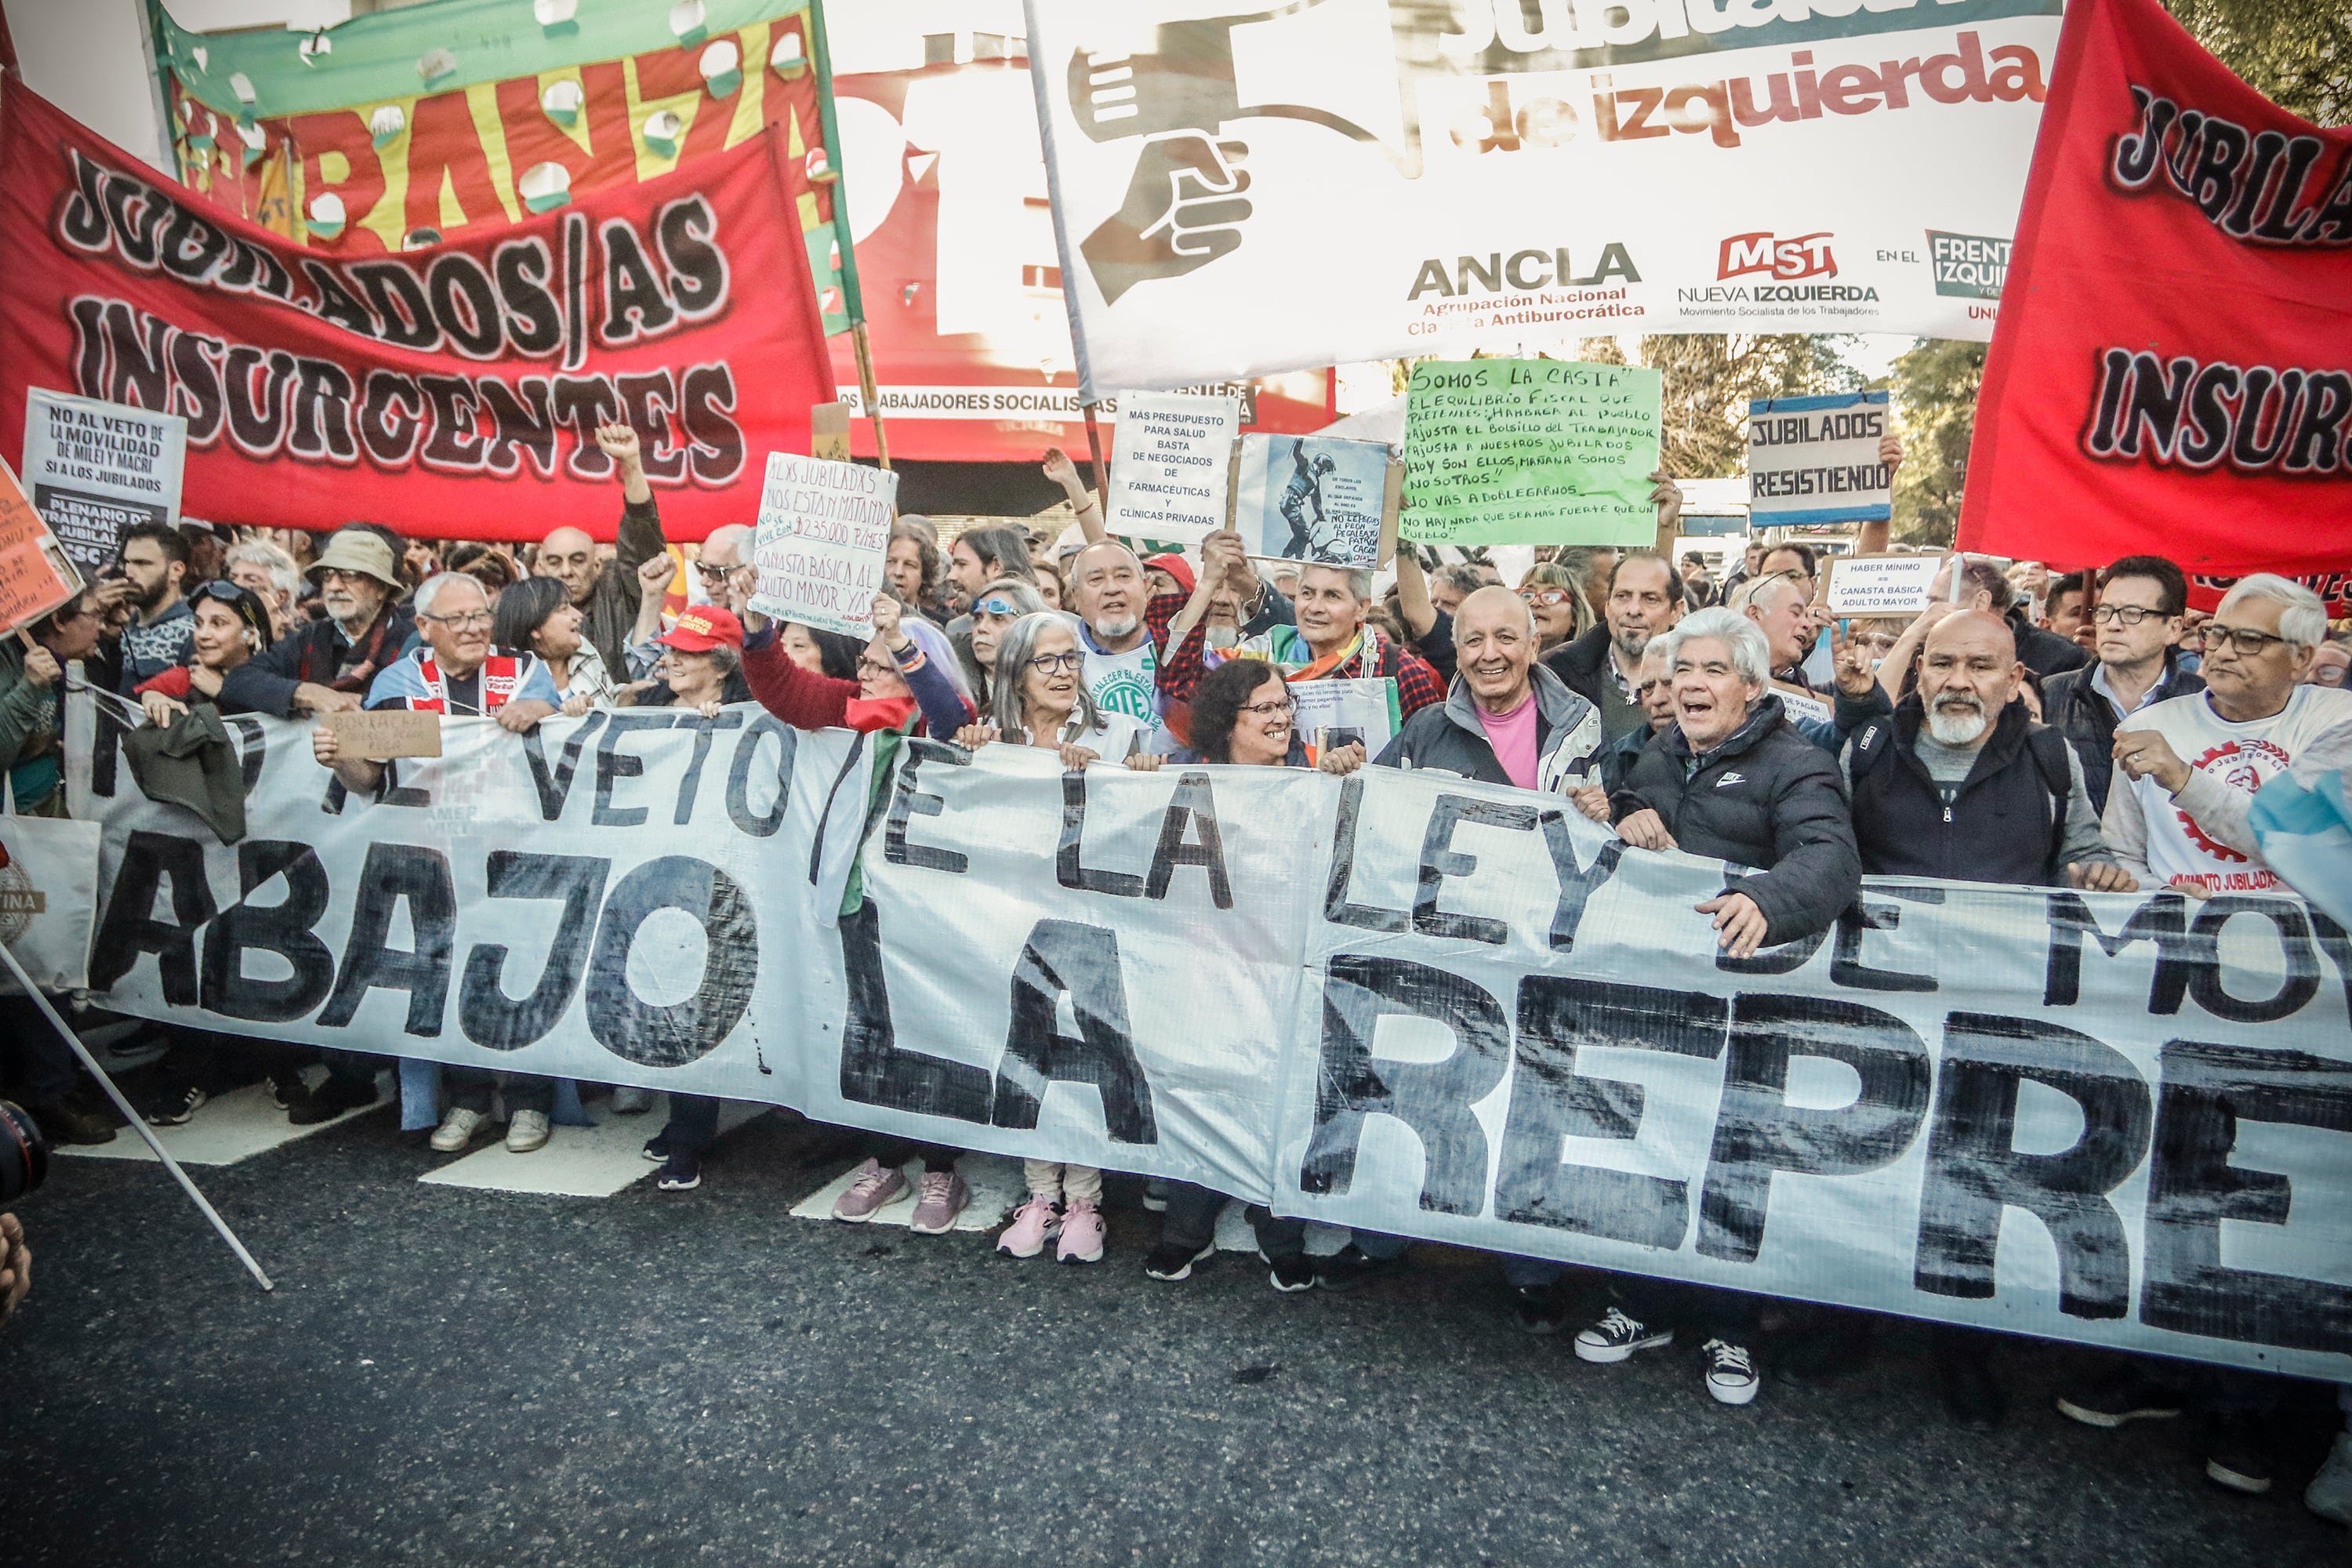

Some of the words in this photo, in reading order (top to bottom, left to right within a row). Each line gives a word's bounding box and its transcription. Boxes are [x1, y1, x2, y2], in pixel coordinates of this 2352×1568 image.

[1449, 81, 1578, 154] de
[1590, 31, 2046, 149] izquierda
[1727, 237, 1832, 276] MST
[1877, 250, 1896, 262] EN
[1902, 251, 1919, 263] EL
[1407, 242, 1642, 301] ANCLA
[1423, 294, 1533, 316] Agrupación
[1541, 287, 1626, 304] Nacional
[1678, 287, 1749, 302] NUEVA
[1754, 286, 1879, 302] IZQUIERDA
[1491, 303, 1644, 326] Antiburocrática
[1679, 307, 1736, 317] Movimiento
[1739, 307, 1784, 316] Socialista
[1788, 307, 1799, 315] de
[1820, 305, 1879, 317] Trabajadores
[71, 294, 746, 485] INSURGENTES
[1411, 368, 1487, 391] SOMOS
[1511, 368, 1532, 385] LA
[880, 394, 990, 411] ABAJADORES
[993, 394, 1117, 413] SOCIALISAS
[1410, 395, 1430, 409] EL
[1600, 394, 1635, 405] QUE
[1569, 408, 1588, 417] AL
[2089, 347, 2352, 474] INSUR
[50, 405, 72, 423] NO
[79, 412, 98, 429] AL
[103, 416, 146, 437] VETO
[151, 425, 164, 441] DE
[1129, 409, 1149, 420] MÁS
[1152, 412, 1224, 426] PRESUPUESTO
[1751, 412, 1882, 446] JUBILADOS
[50, 424, 62, 440] LA
[66, 426, 159, 457] MOVILIDAD
[1144, 426, 1171, 435] PARA
[1174, 427, 1206, 438] SALUD
[1466, 425, 1483, 434] EL
[57, 441, 71, 459] DE
[74, 445, 103, 465] MILEI
[107, 451, 114, 467] Y
[117, 453, 152, 474] MACRI
[1157, 441, 1189, 451] BASTA
[1133, 452, 1145, 461] DE
[1148, 453, 1212, 466] NEGOCIADOS
[1443, 458, 1467, 470] SON
[1520, 455, 1571, 466] MAÑANA
[1578, 454, 1625, 465] SOMOS
[45, 459, 57, 474] SI
[60, 464, 67, 475] A
[71, 465, 93, 480] LOS
[96, 470, 162, 492] JUBILADOS
[801, 461, 876, 494] JUBILADXS
[1164, 468, 1178, 477] DE
[1753, 464, 1889, 498] RESISTIENDO
[1128, 481, 1210, 497] FARMACÉUTICAS
[1436, 495, 1461, 506] VAS
[50, 498, 127, 524] PLENARIO
[766, 488, 789, 510] NOS
[794, 491, 837, 519] ESTAN
[840, 496, 892, 526] MATANDO
[1120, 508, 1163, 521] CLÍNICAS
[1166, 513, 1214, 525] PRIVADAS
[1332, 514, 1344, 523] NO
[1426, 517, 1446, 528] HAY
[1450, 515, 1479, 525] NADA
[1483, 513, 1504, 524] QUE
[1508, 511, 1531, 521] SEA
[1614, 504, 1635, 516] QUE
[1639, 504, 1653, 514] UN
[759, 513, 771, 526] NO
[773, 515, 784, 527] SE
[757, 531, 773, 545] VIVE
[776, 520, 792, 536] CON
[757, 551, 805, 576] CANASTA
[857, 564, 873, 589] AL
[1850, 564, 1882, 572] HABER
[1887, 563, 1920, 572] MÍNIMO
[797, 581, 840, 611] MAYOR
[1887, 585, 1923, 594] BÁSICA
[1842, 597, 1880, 607] ADULTO
[1882, 597, 1917, 606] MAYOR
[1105, 686, 1146, 720] ATE
[521, 710, 797, 837] VETO
[1056, 769, 1233, 909] LA
[1324, 775, 1630, 953] LEY
[88, 829, 758, 1069] ABAJO
[840, 895, 1158, 1144] LA
